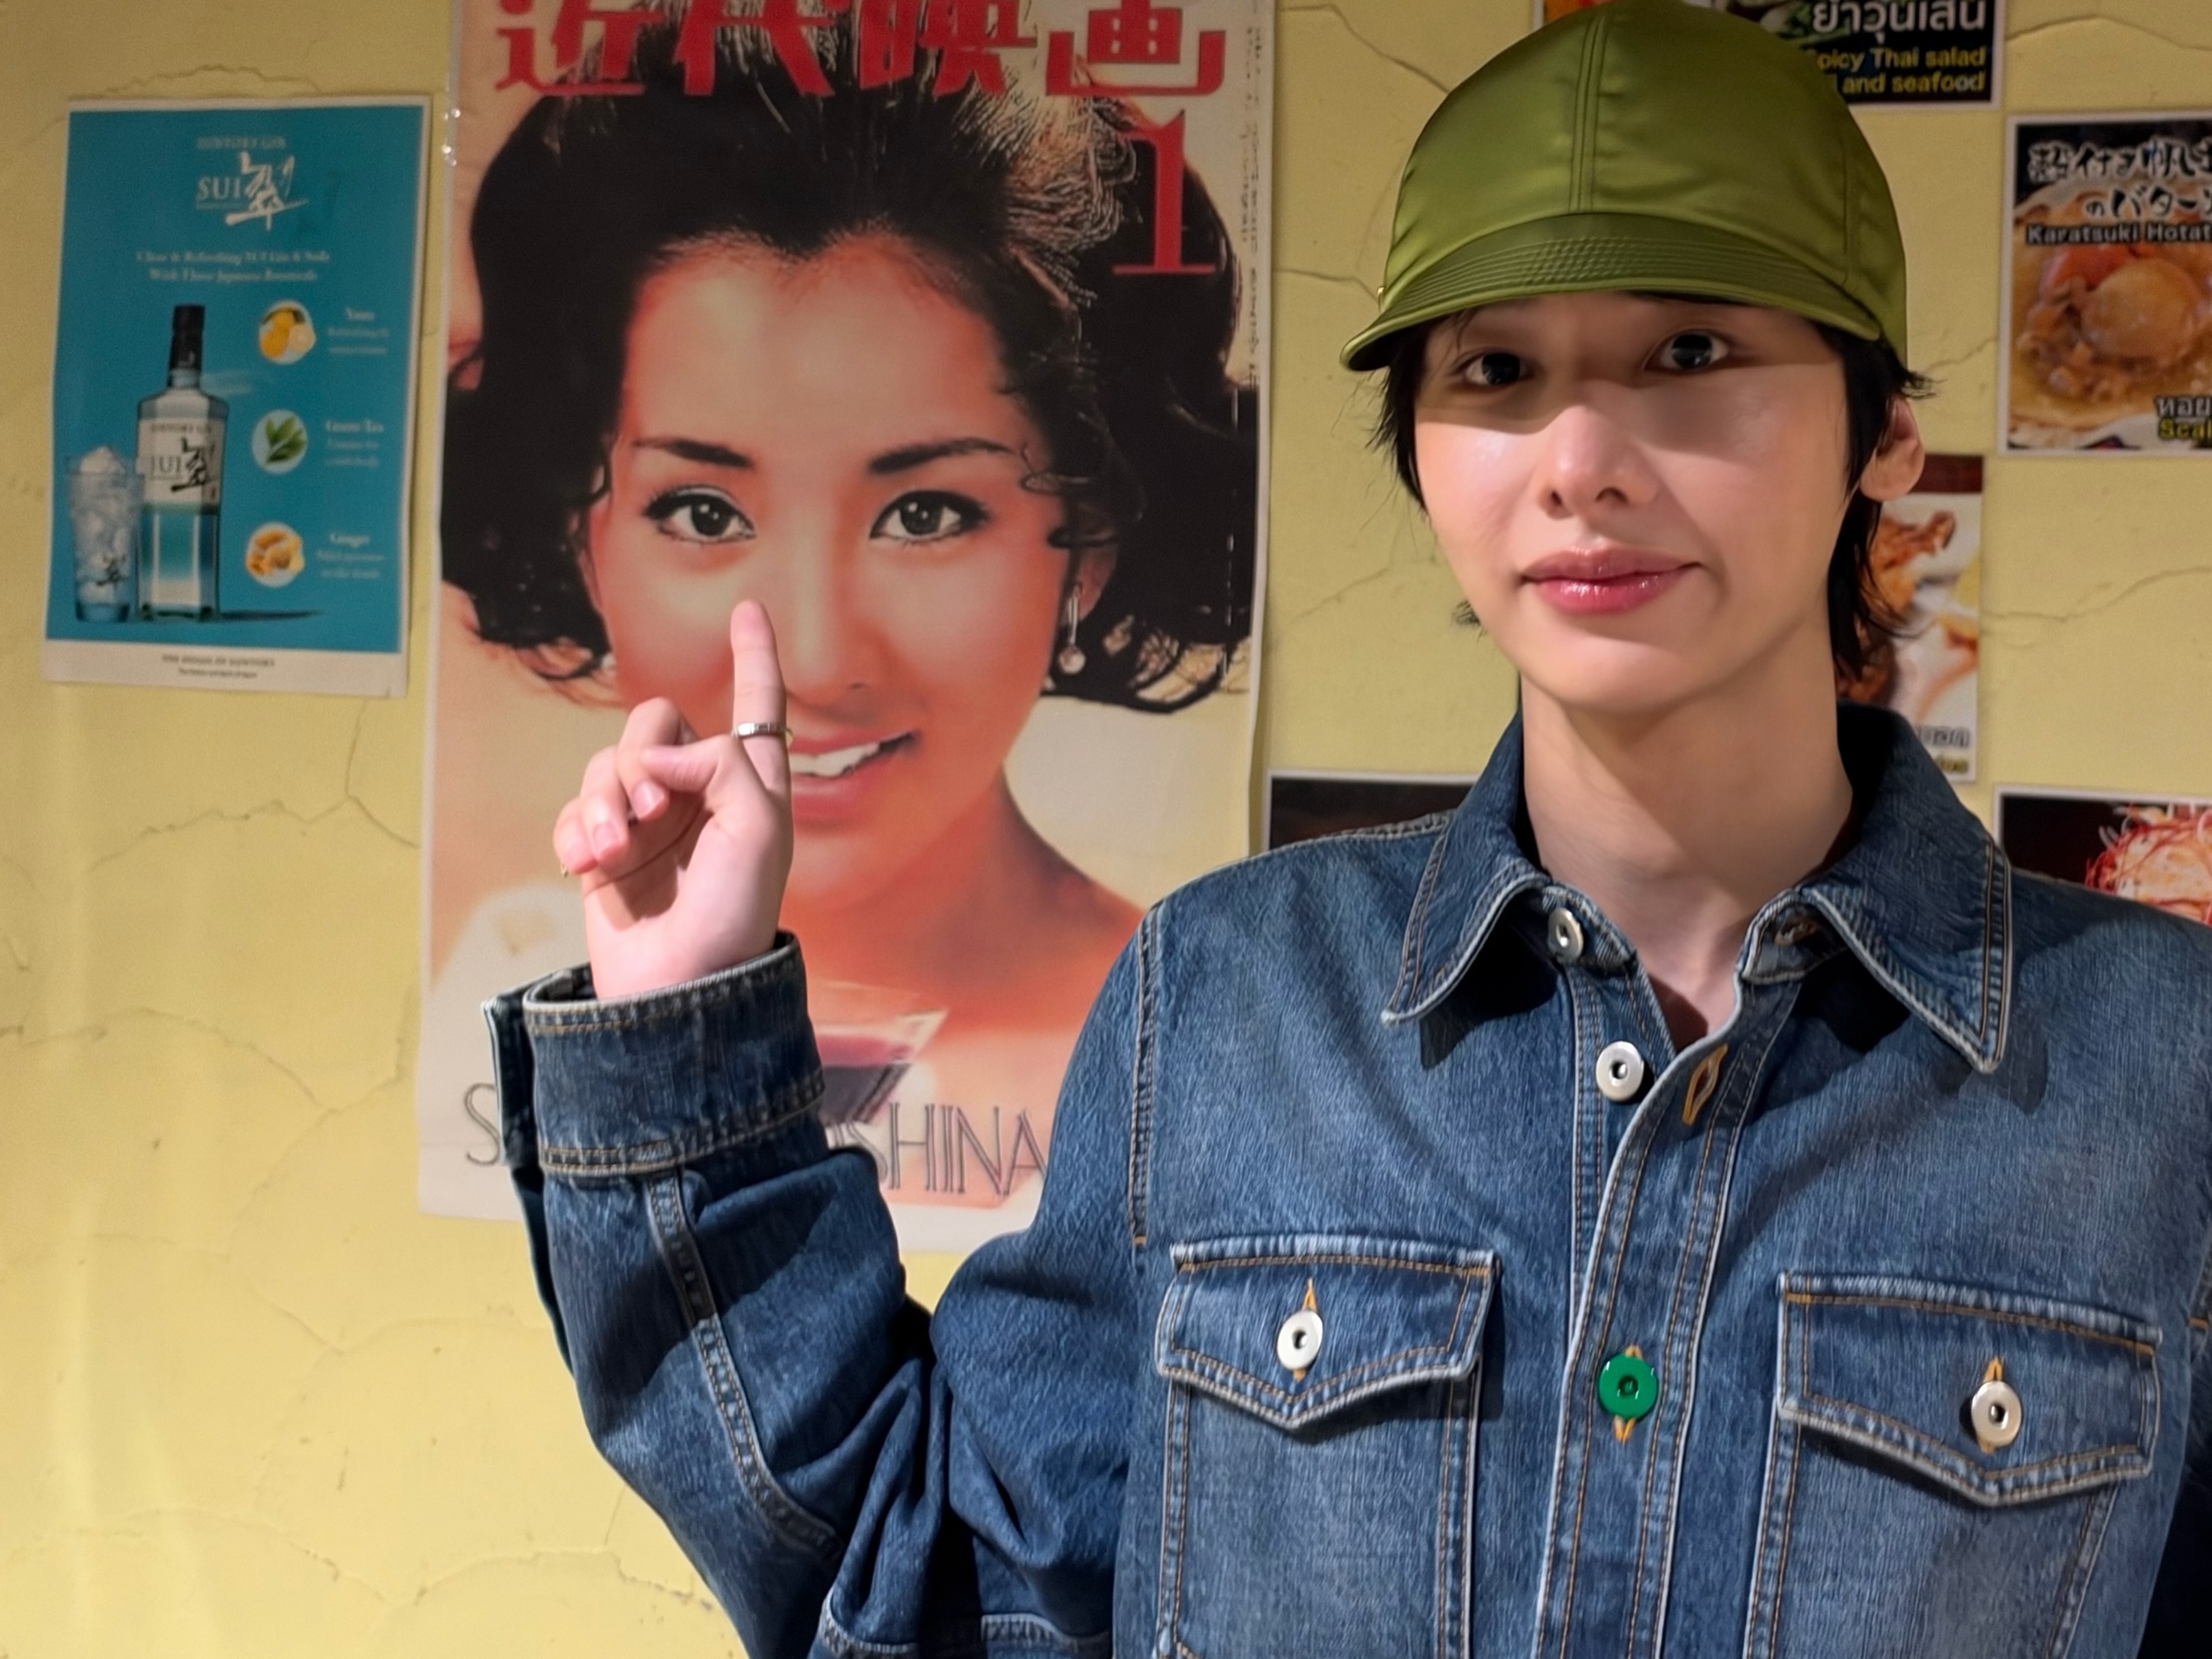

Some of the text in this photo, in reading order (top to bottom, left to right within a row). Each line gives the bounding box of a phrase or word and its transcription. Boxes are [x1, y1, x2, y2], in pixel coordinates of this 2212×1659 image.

[1816, 45, 1987, 72] picy Thai salad
[1842, 71, 1987, 94] and seafood
[198, 176, 241, 200] SUI
[2085, 185, 2212, 217] のバター
[2028, 222, 2212, 243] Karatsuki Hotat
[2156, 397, 2212, 416] หอย
[2160, 419, 2212, 439] Scal
